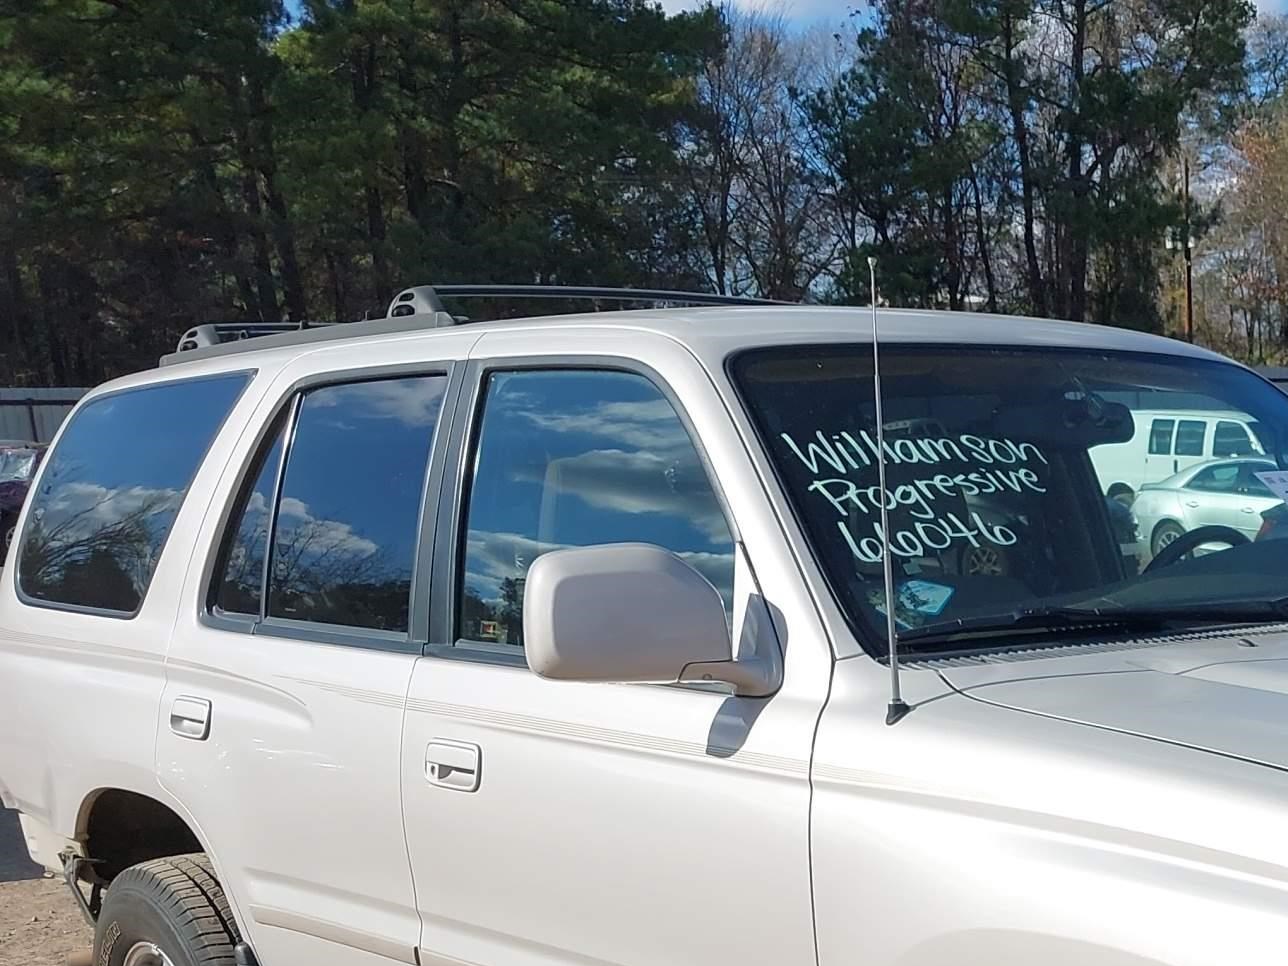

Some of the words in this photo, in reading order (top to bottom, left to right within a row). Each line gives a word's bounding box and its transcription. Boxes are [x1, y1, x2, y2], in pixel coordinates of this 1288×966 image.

[781, 430, 1048, 474] Williamson
[808, 467, 1046, 519] Progressive
[837, 511, 1017, 563] 66046
